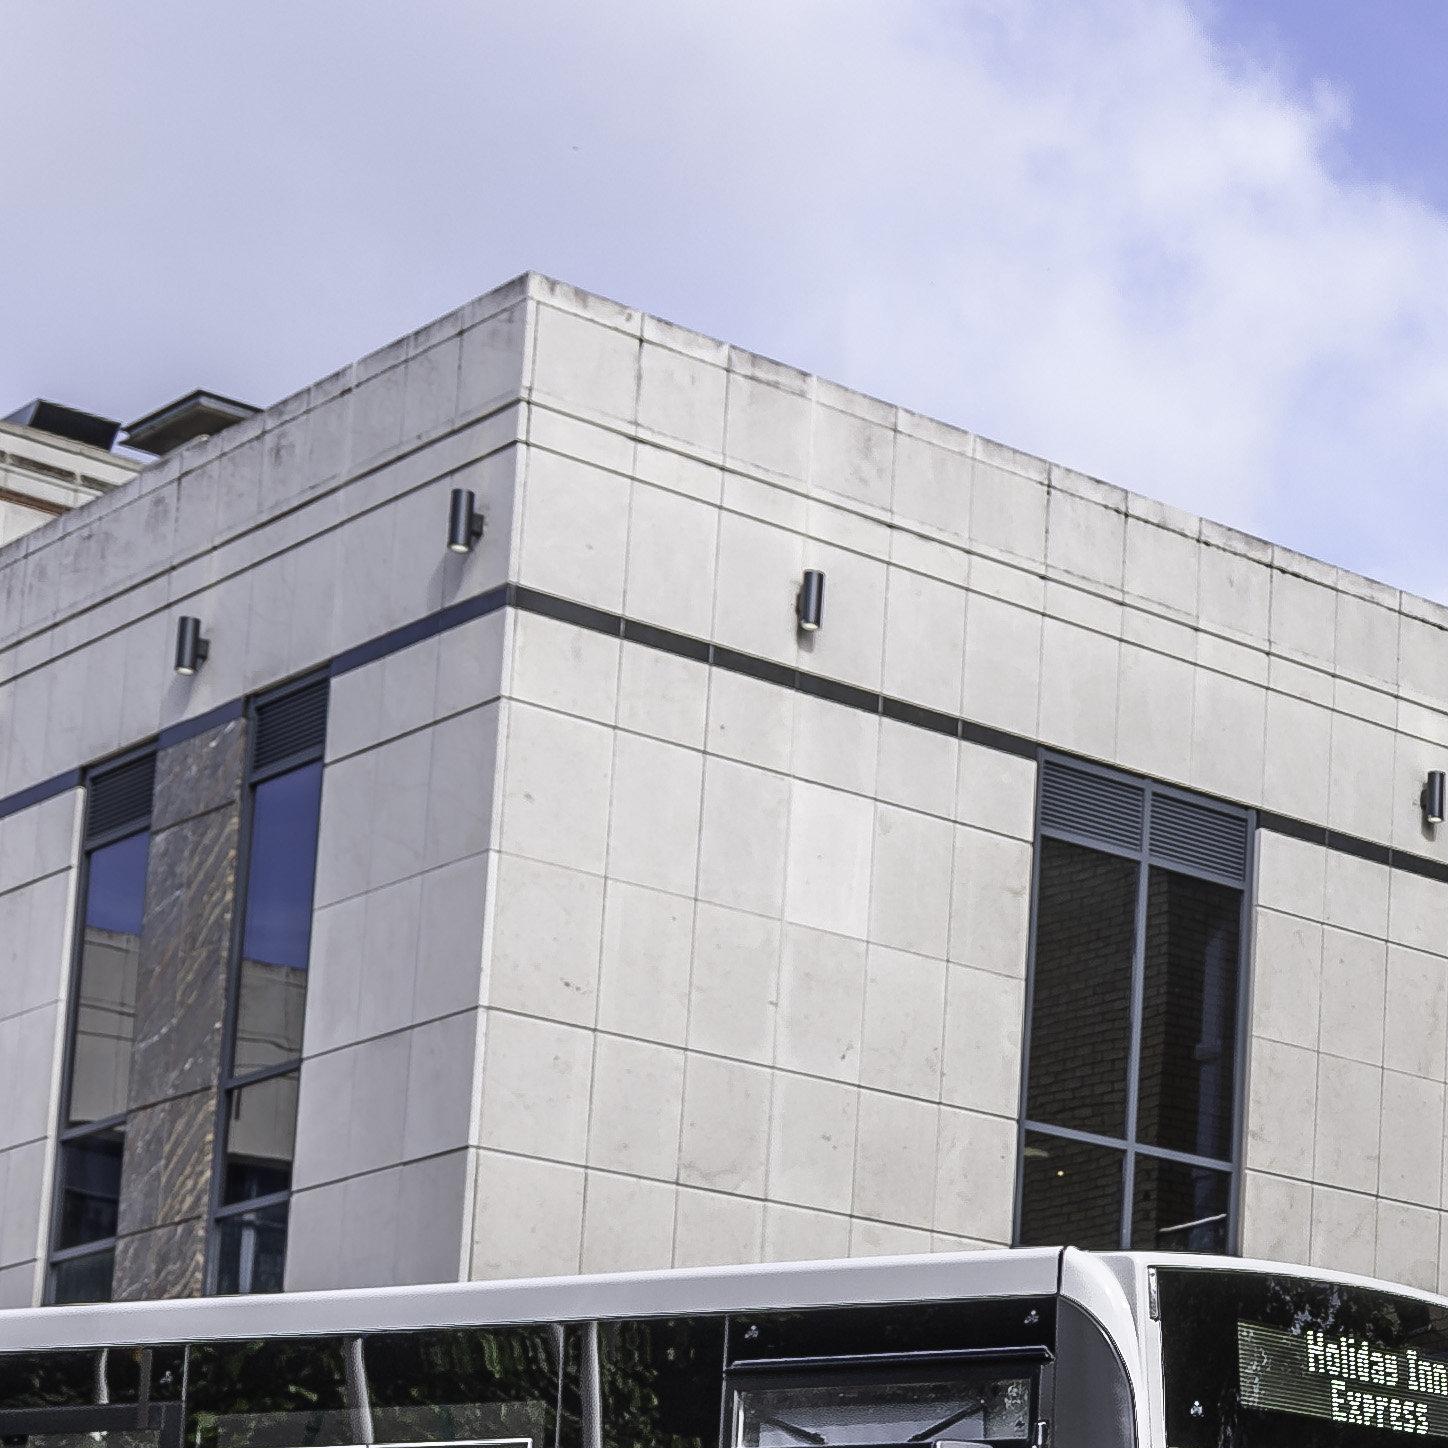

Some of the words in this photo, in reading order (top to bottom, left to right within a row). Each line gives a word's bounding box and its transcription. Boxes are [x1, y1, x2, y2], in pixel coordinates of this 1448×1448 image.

[1306, 1330, 1399, 1387] Holiday
[1406, 1349, 1448, 1396] Inn
[1330, 1379, 1429, 1435] Express
